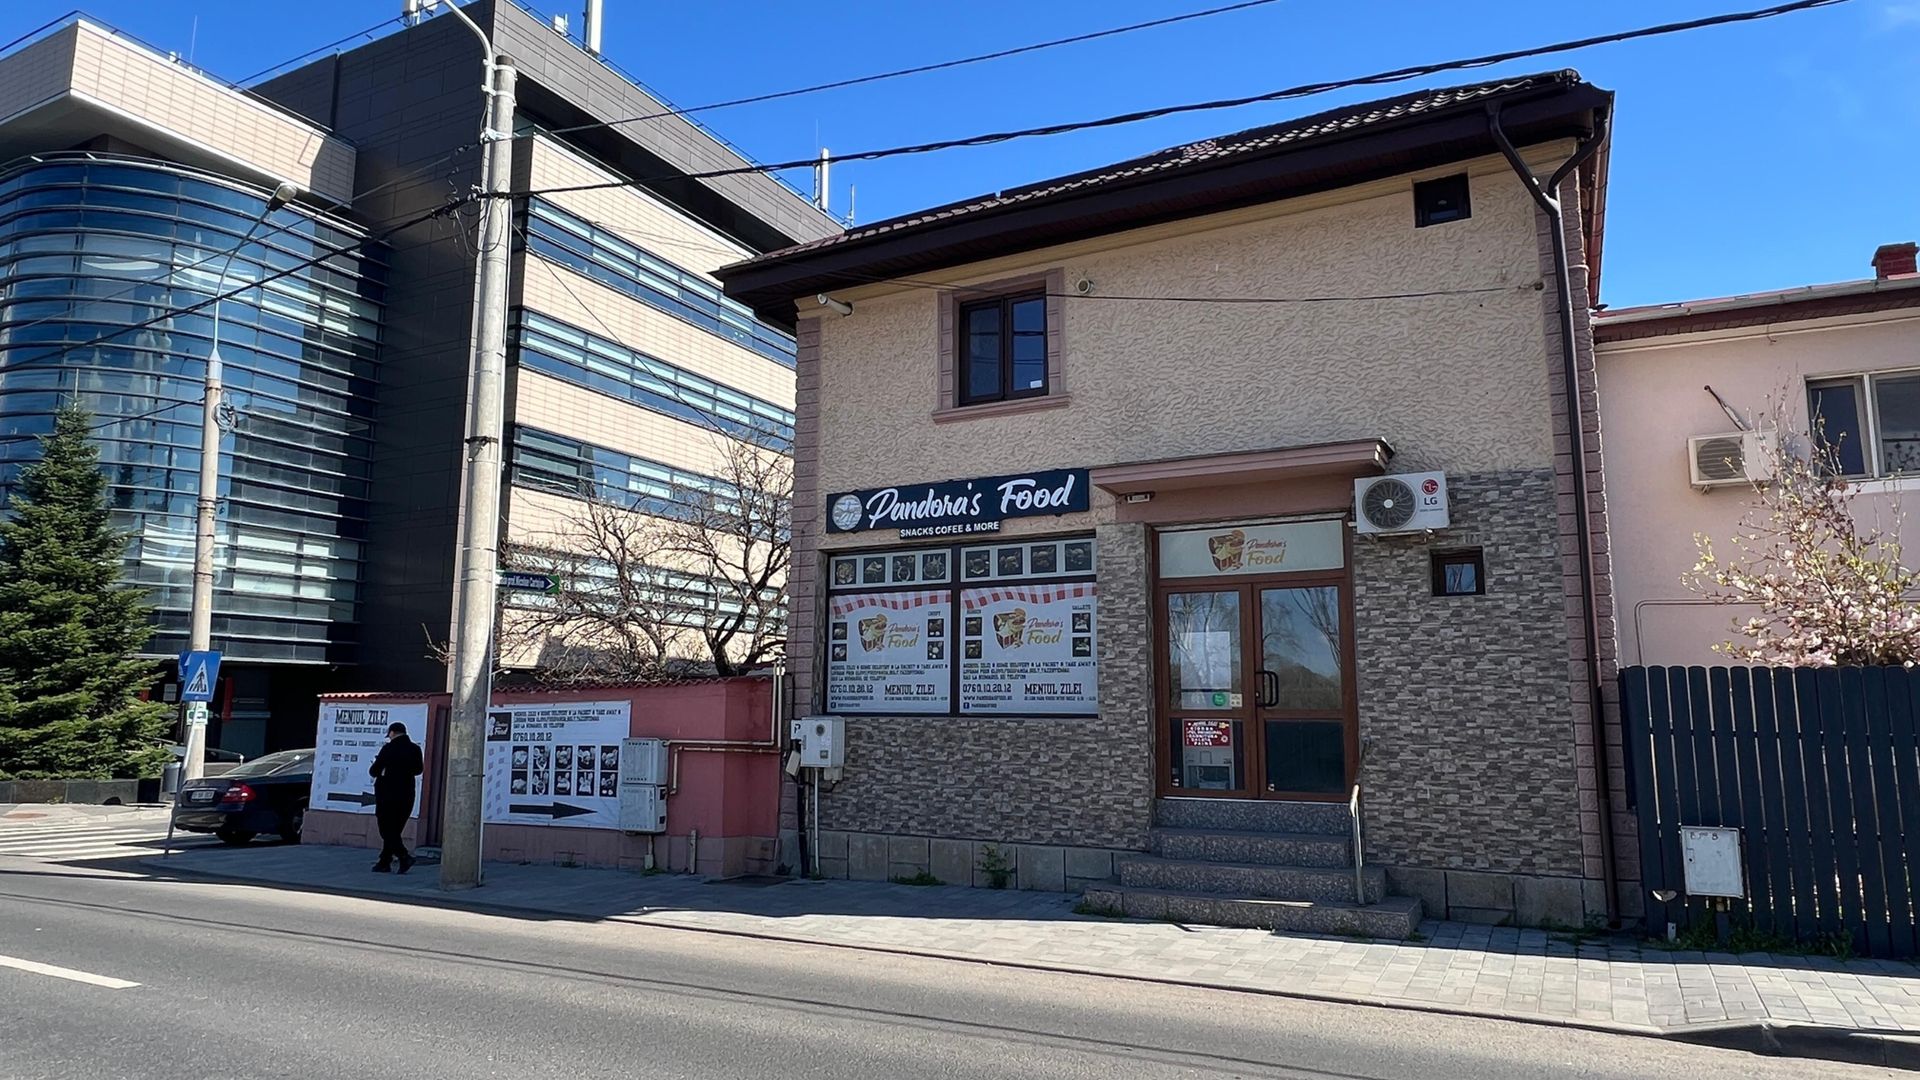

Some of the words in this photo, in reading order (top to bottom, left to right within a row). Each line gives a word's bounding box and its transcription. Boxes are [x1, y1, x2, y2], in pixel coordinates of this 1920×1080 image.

[866, 482, 982, 529] Pandora's
[997, 474, 1076, 513] Food
[1424, 497, 1437, 505] LG
[900, 527, 934, 537] SNACKS
[935, 525, 963, 534] COFEE
[966, 524, 972, 532] &
[974, 521, 999, 531] MORE
[1247, 549, 1285, 566] Food
[886, 634, 919, 649] Food
[1026, 629, 1062, 645] Food
[884, 684, 914, 695] MENIUL
[916, 684, 936, 695] ZILEI
[962, 684, 1012, 692] 0760.10.20.12
[1024, 684, 1057, 694] MENIUL
[1060, 684, 1082, 694] ZILEI
[335, 709, 366, 725] MENIUL
[367, 710, 388, 726] ZILEI
